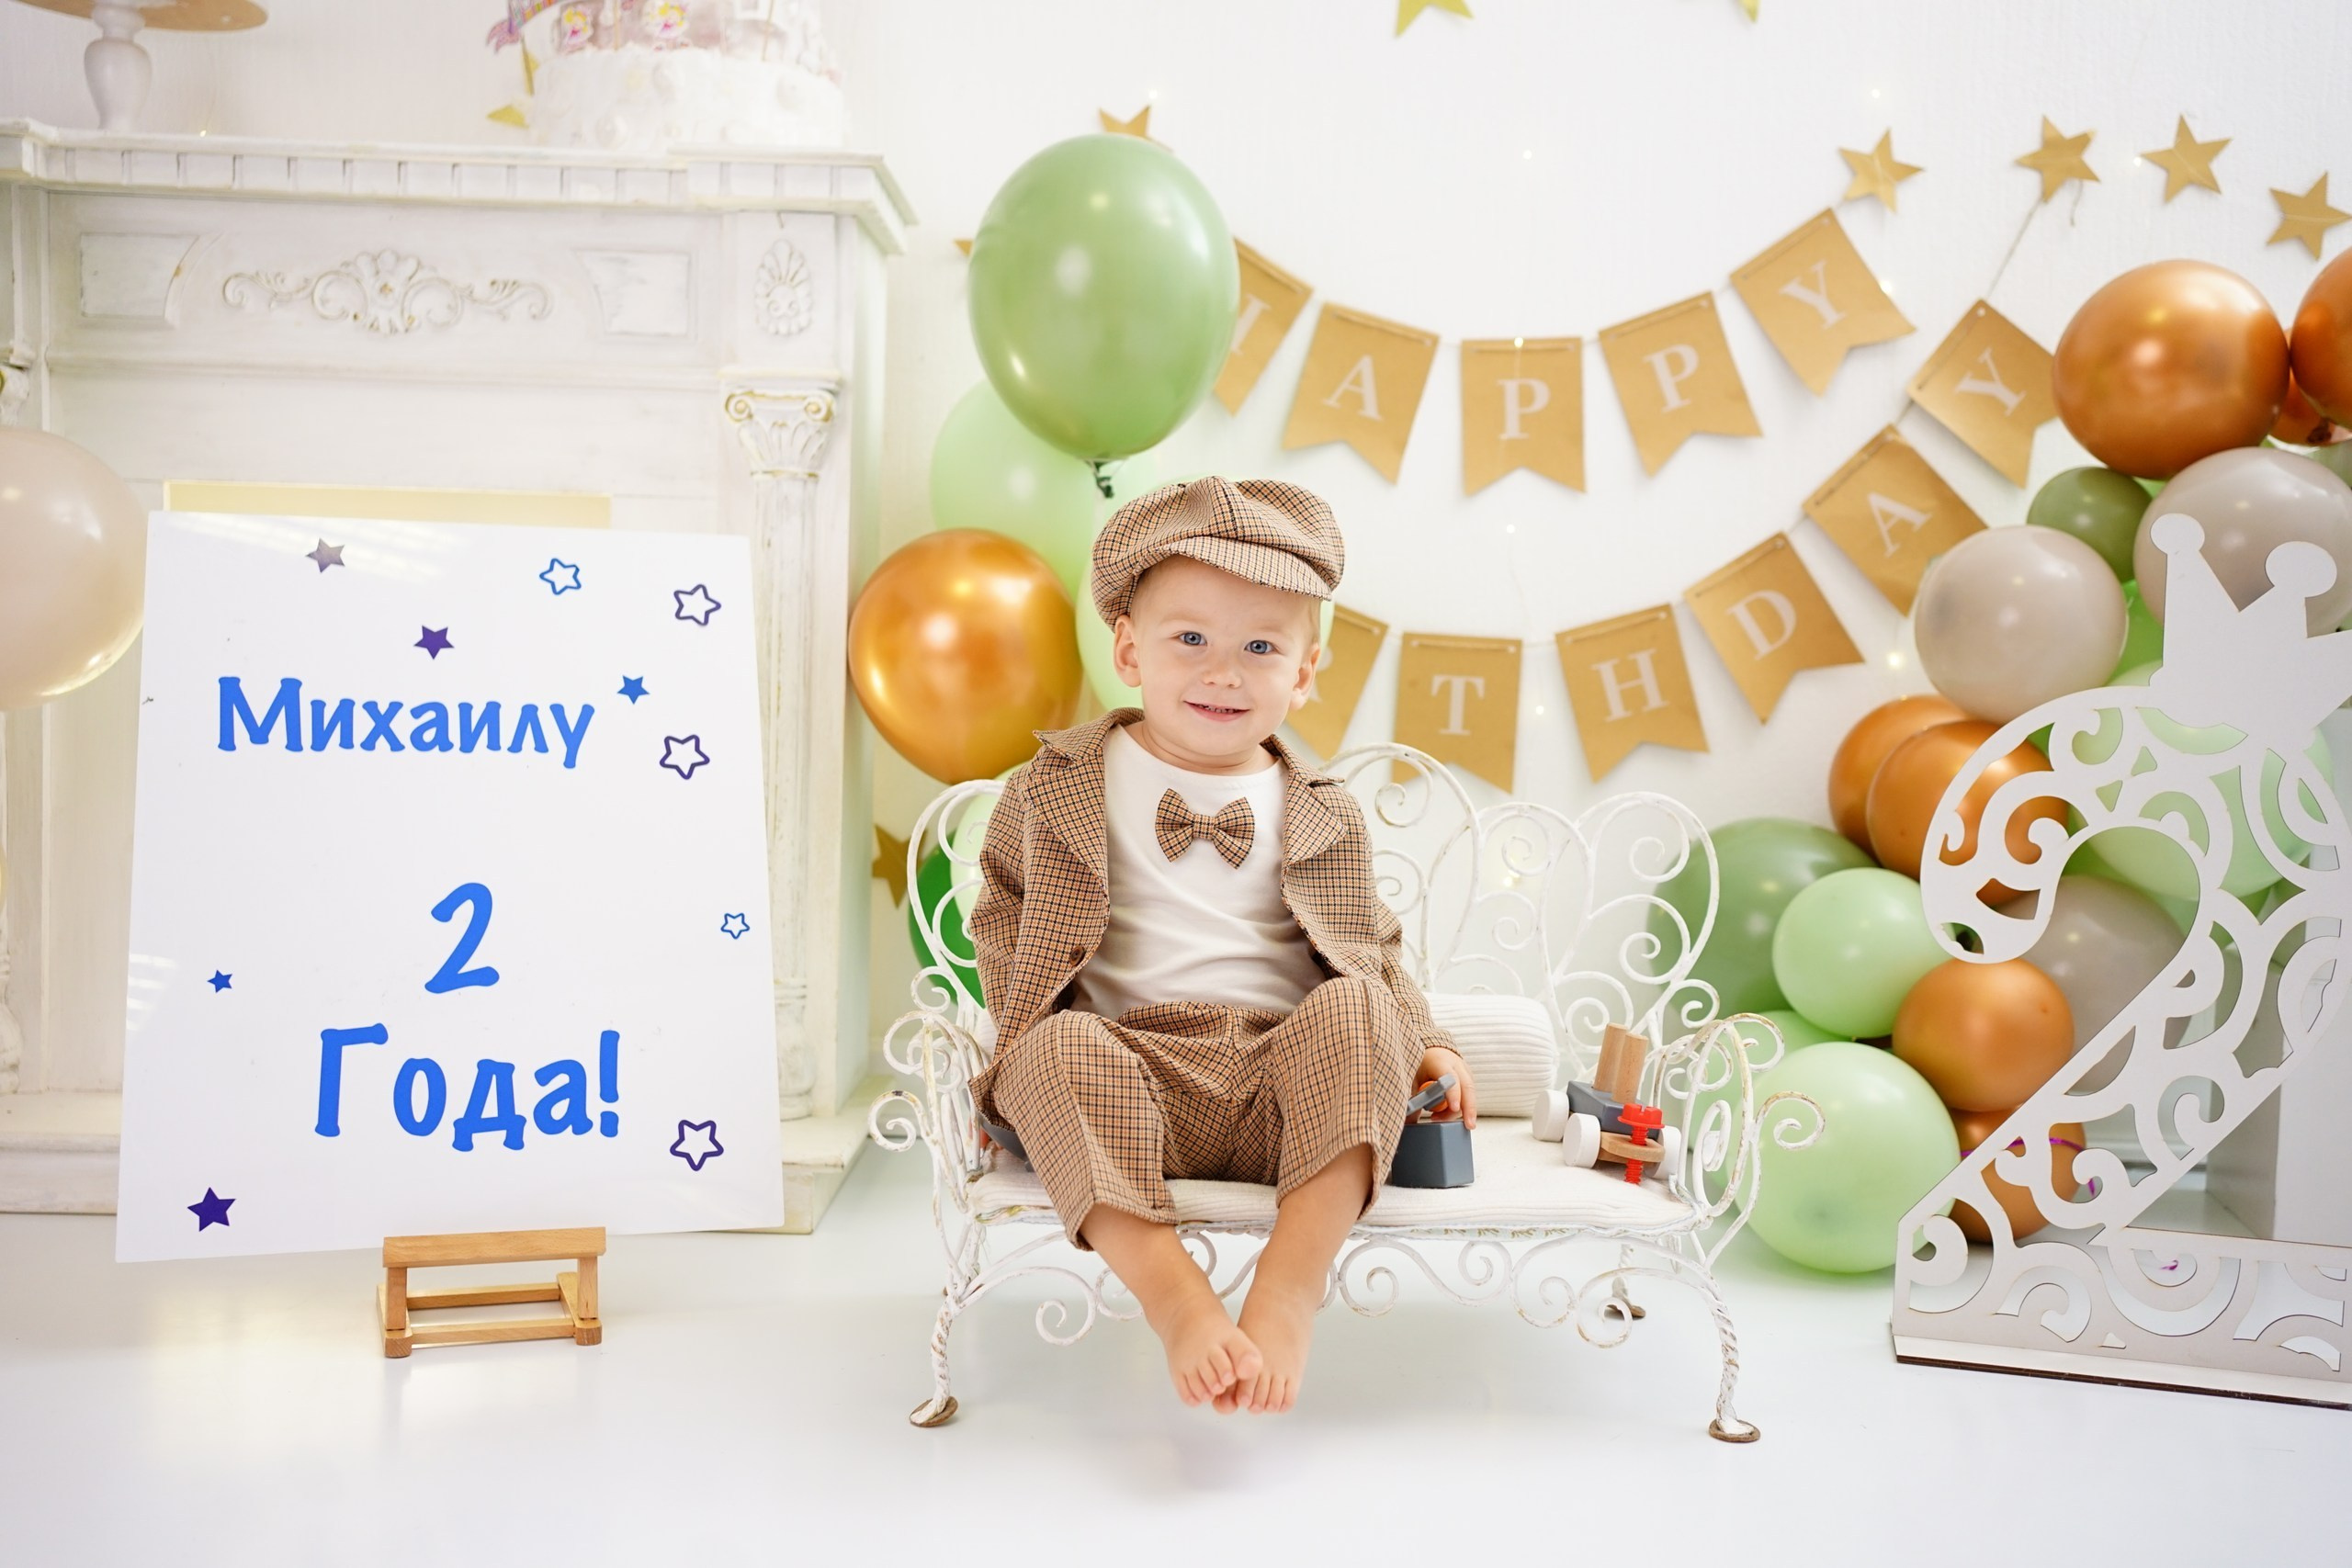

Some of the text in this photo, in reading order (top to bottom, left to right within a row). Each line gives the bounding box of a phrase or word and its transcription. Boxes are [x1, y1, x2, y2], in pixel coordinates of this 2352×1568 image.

[1308, 347, 2027, 737] THDAY
[218, 676, 595, 769] Михаилу
[424, 882, 500, 995] 2
[314, 1022, 621, 1153] Года!
